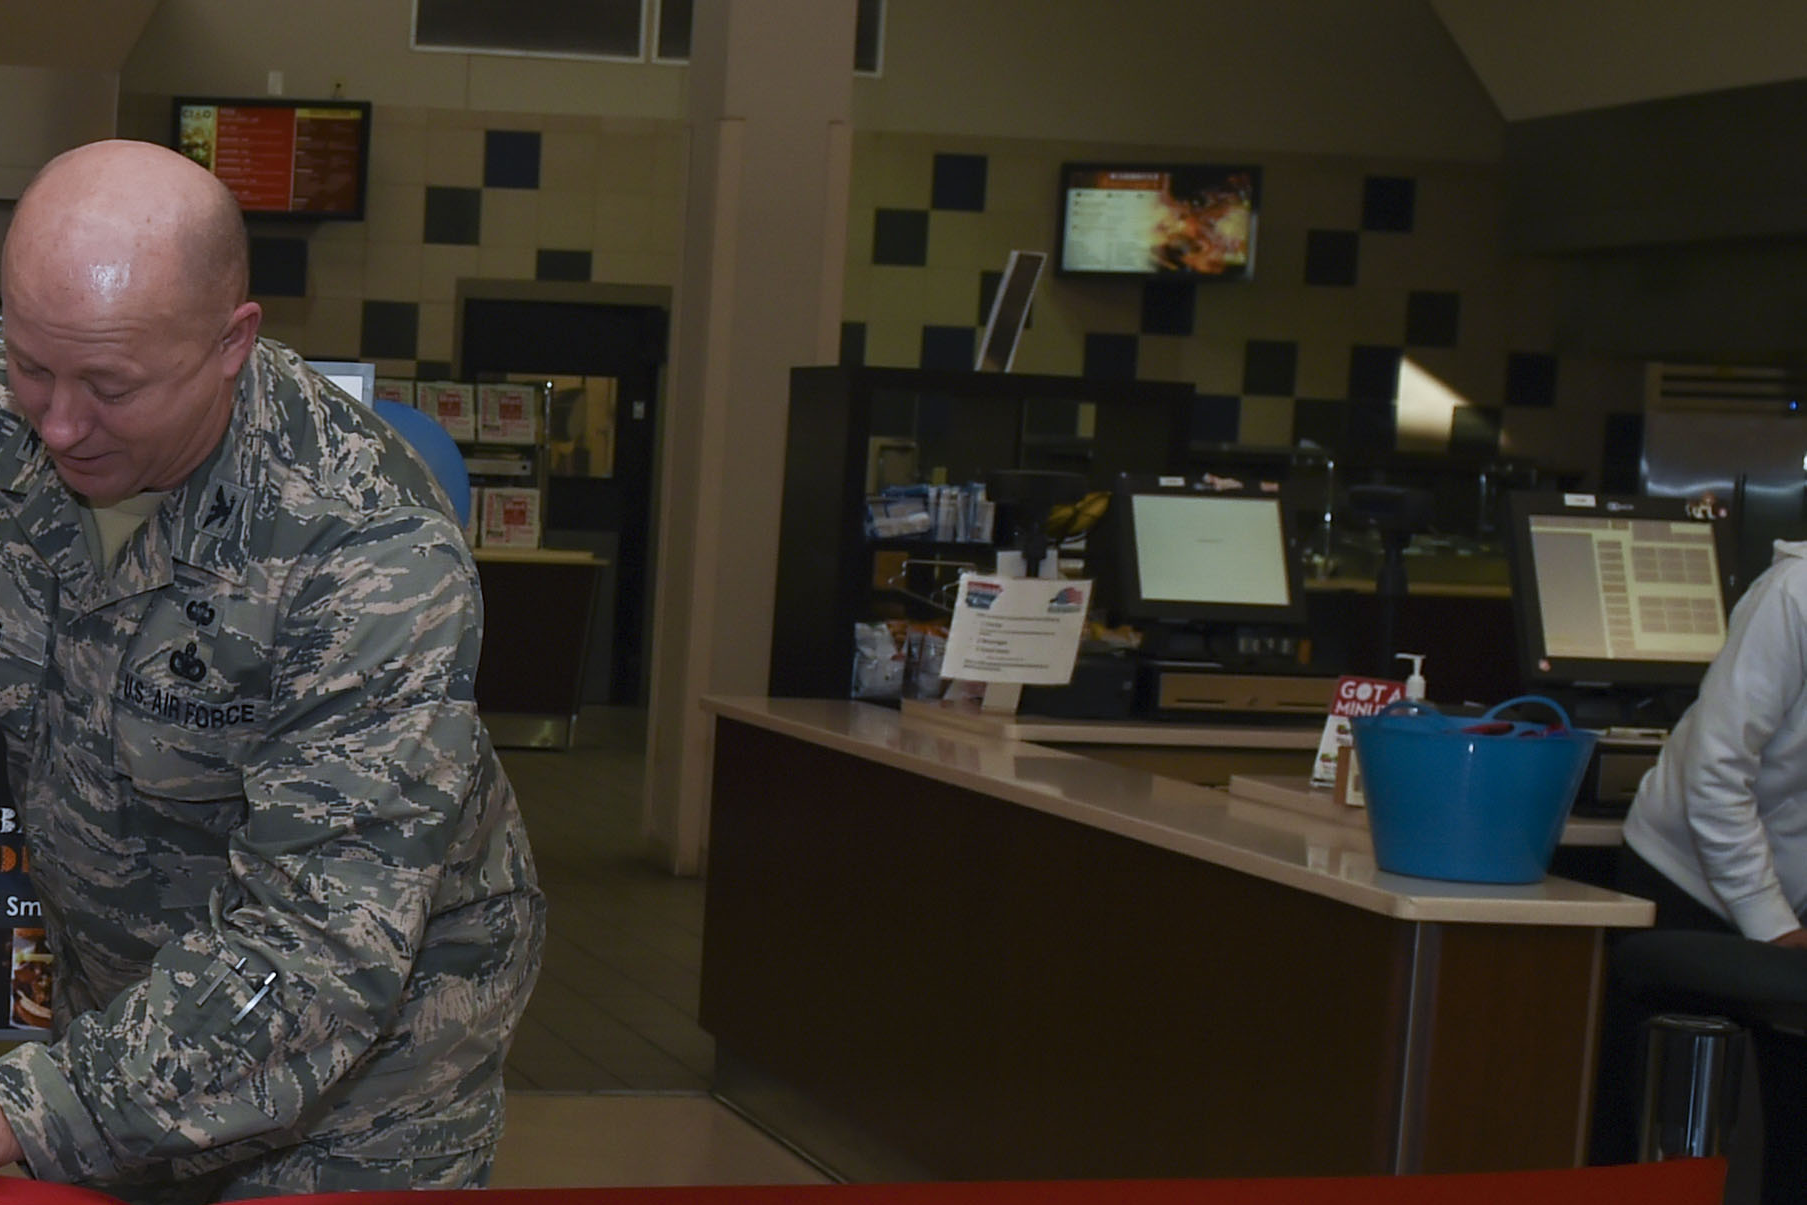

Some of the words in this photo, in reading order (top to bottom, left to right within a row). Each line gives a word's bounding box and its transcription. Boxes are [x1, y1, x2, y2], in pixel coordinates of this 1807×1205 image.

[1340, 681, 1387, 702] GOT
[1387, 687, 1401, 705] A
[152, 689, 180, 721] AIR
[184, 702, 255, 729] FORCE
[6, 895, 42, 917] Sm
